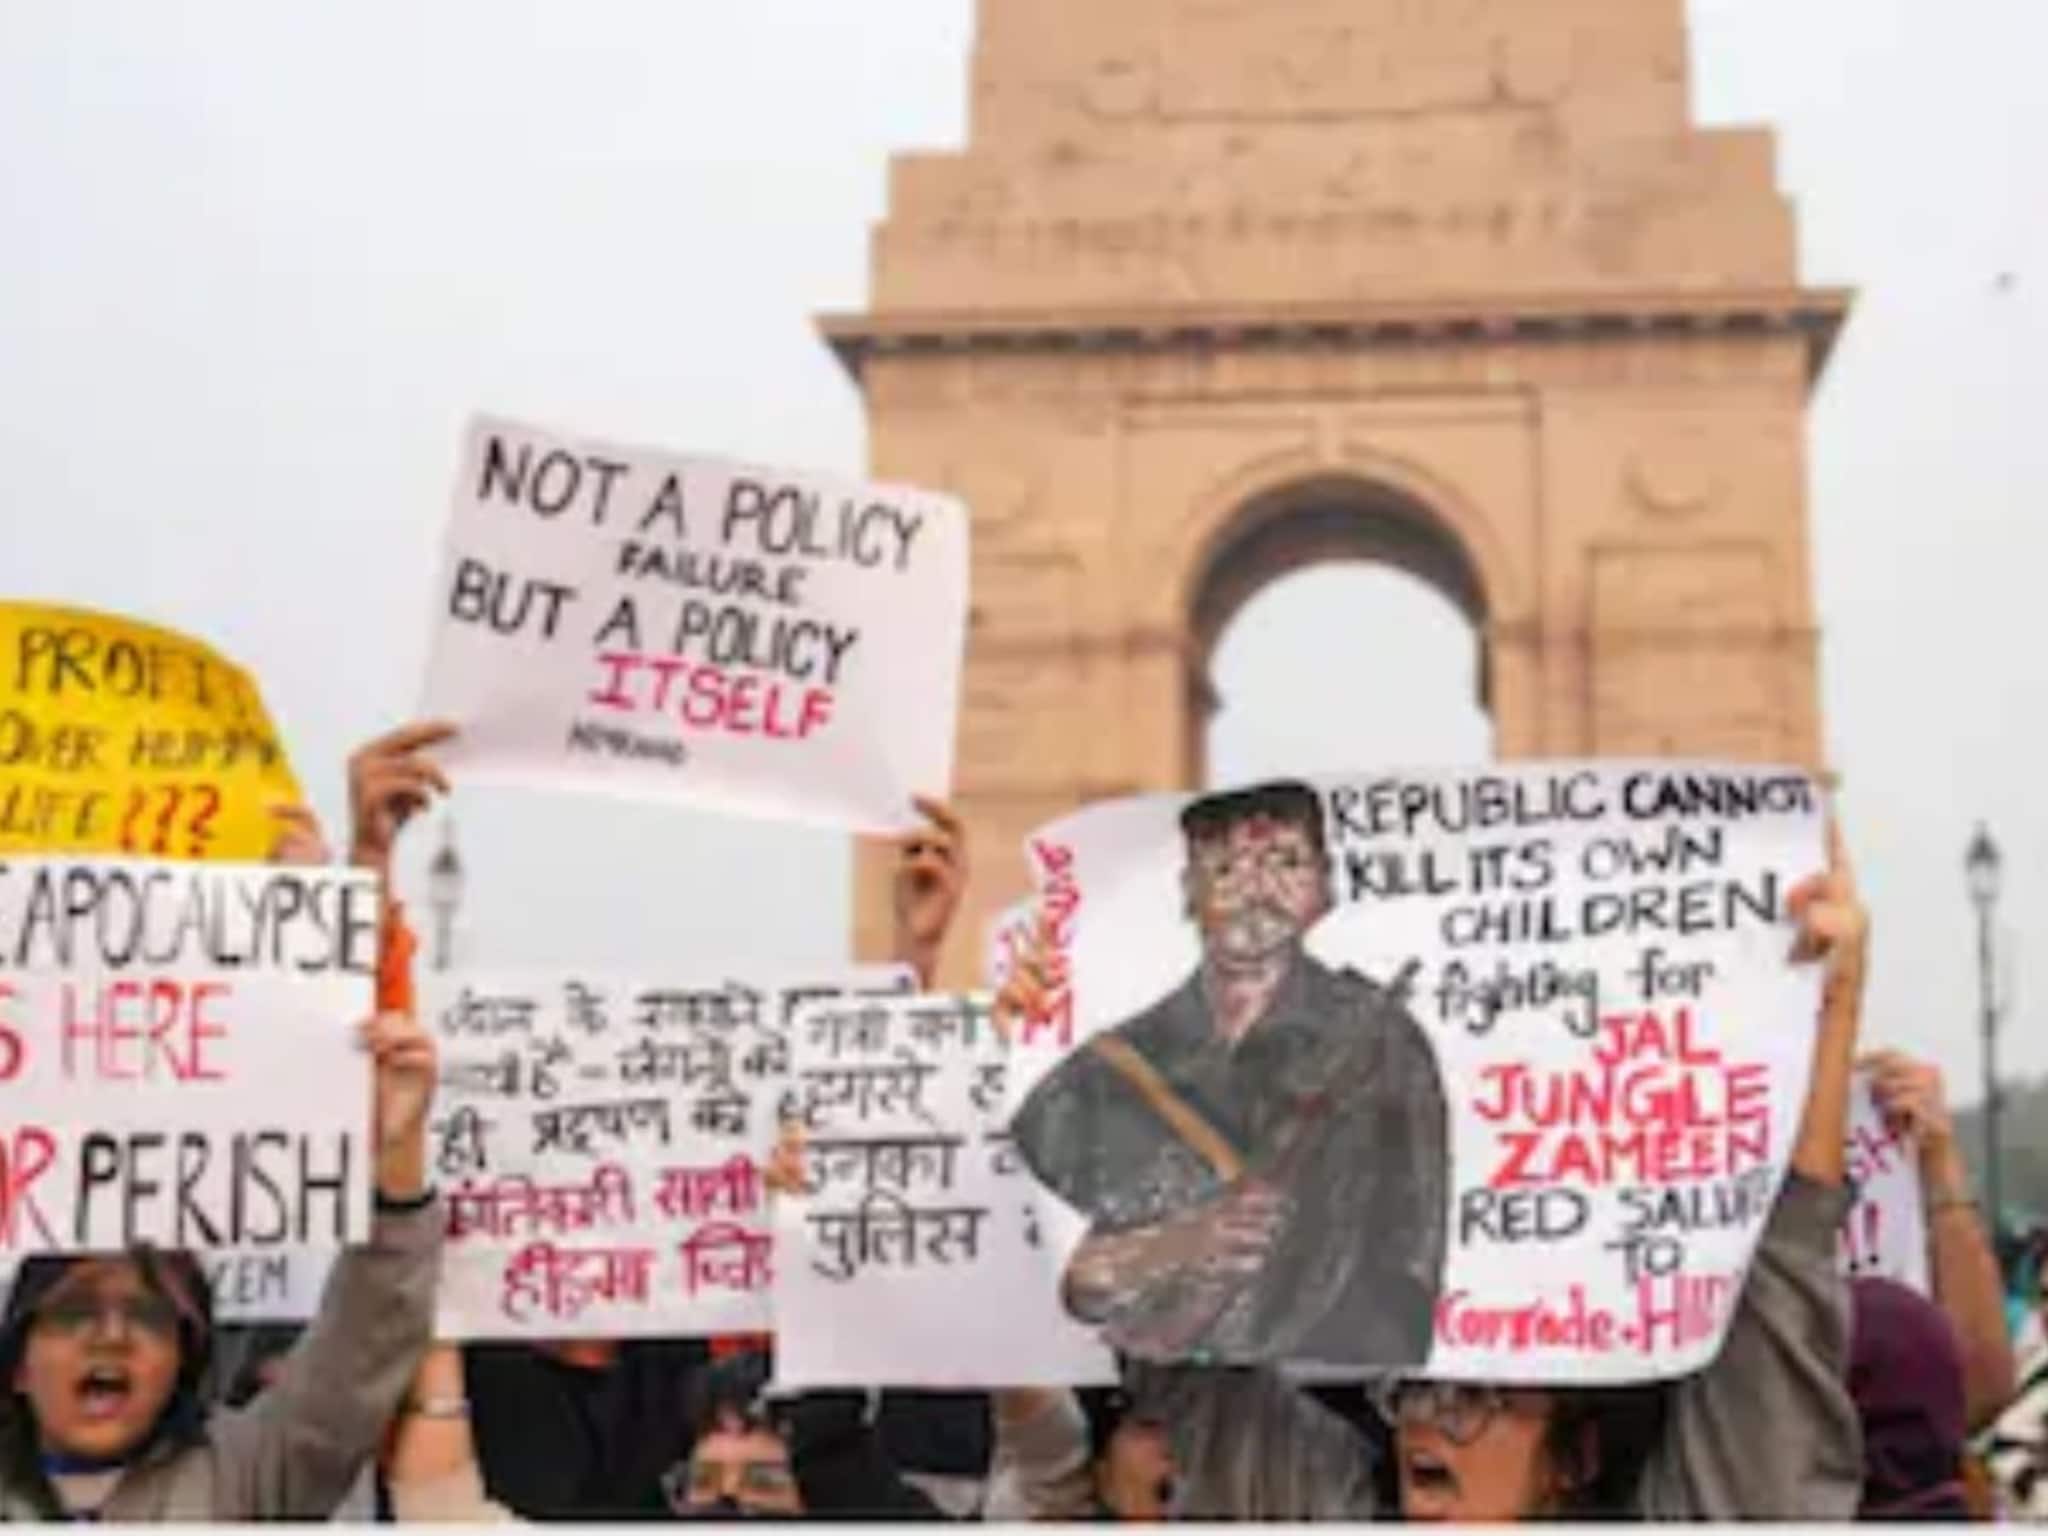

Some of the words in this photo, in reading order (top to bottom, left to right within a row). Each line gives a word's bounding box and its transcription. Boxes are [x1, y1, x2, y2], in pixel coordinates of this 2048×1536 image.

[477, 437, 630, 526] NOT
[639, 472, 687, 538] A
[722, 477, 923, 570] POLICY
[617, 541, 807, 607] FAILURE
[449, 559, 578, 639] BUT
[594, 597, 641, 650] A
[674, 599, 859, 686] POLICY
[588, 653, 834, 739] ITSELF
[1330, 772, 1603, 838] REPUBLIC
[1622, 774, 1815, 821] CANNOT
[1346, 850, 1455, 901] KILL
[1468, 837, 1556, 895] ITS
[1580, 825, 1723, 880] OWN
[15, 867, 377, 972] APOCALYPSE
[1440, 871, 1780, 944] CHILDREN
[1431, 956, 1601, 1037] fighting
[1626, 948, 1716, 1001] for
[62, 978, 232, 1082] HERE
[1594, 1006, 1721, 1064] JAL
[1473, 1062, 1770, 1129] JUNGLE
[74, 1131, 350, 1247] PERISH
[1493, 1123, 1769, 1188] ZAMEEN
[1459, 1187, 1590, 1246] RED
[1603, 1236, 1684, 1288] TO
